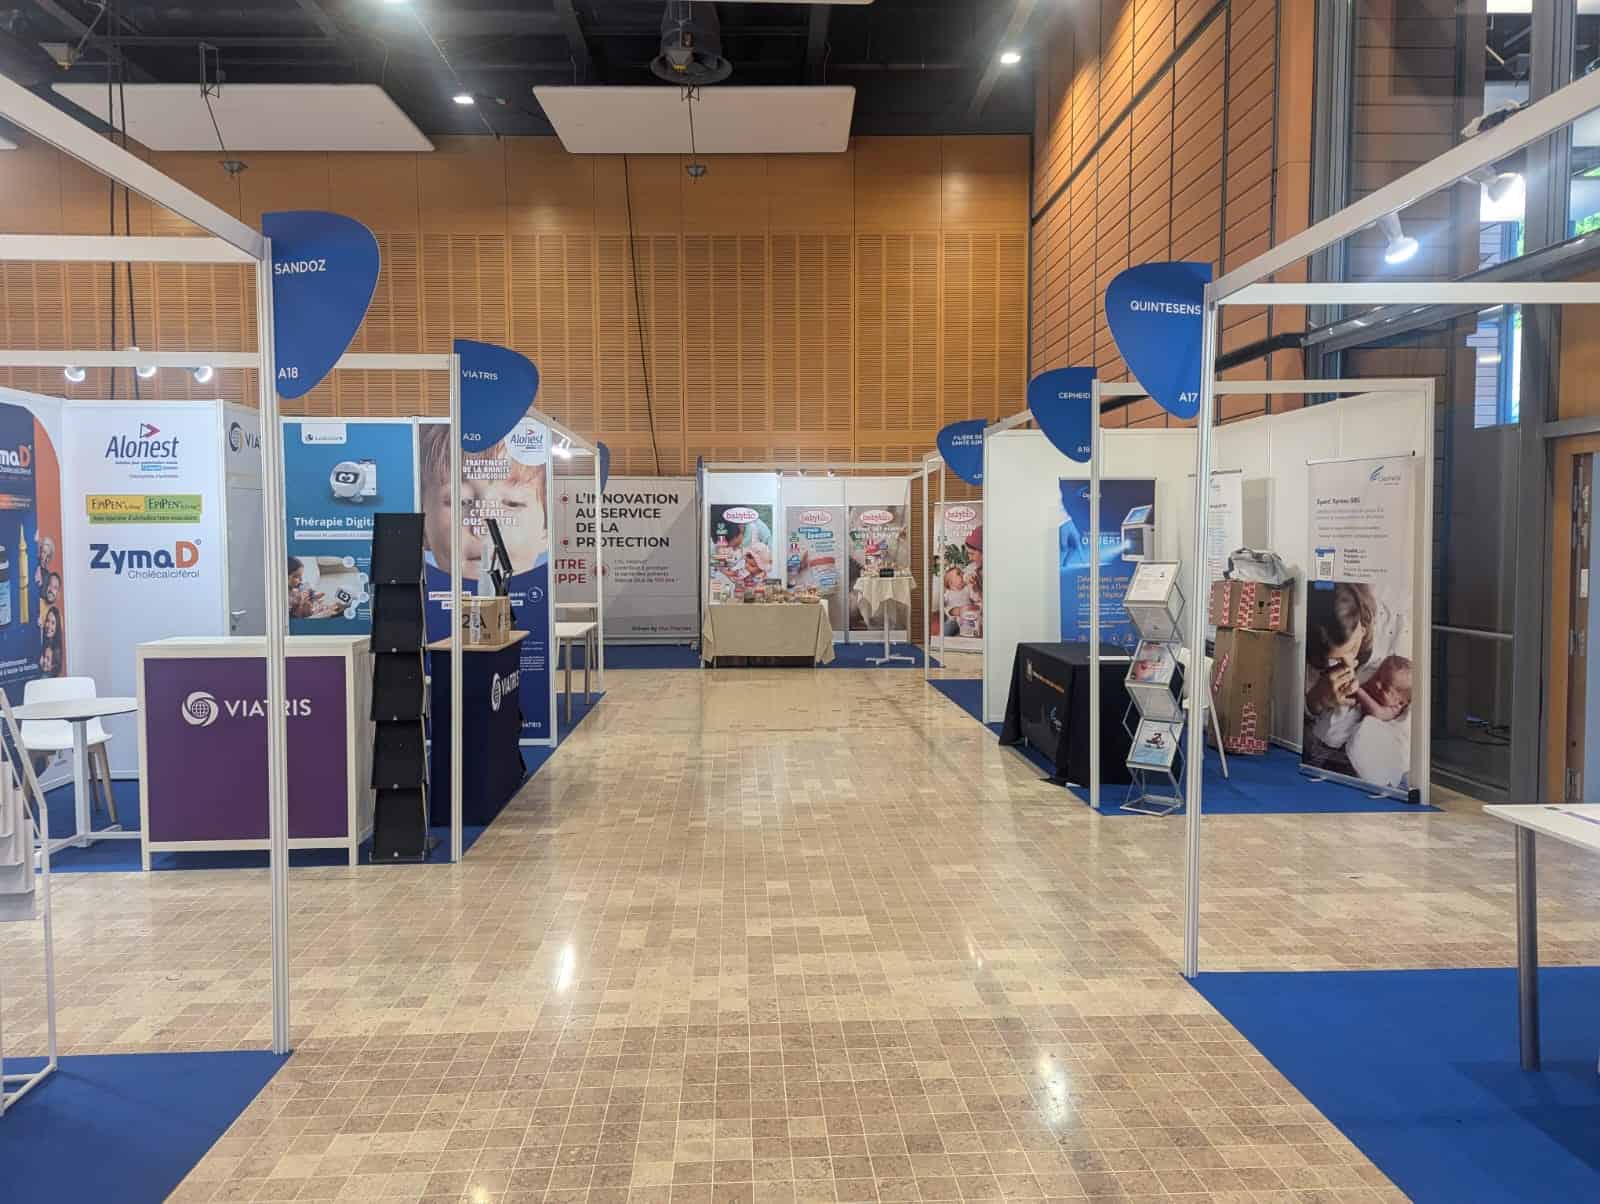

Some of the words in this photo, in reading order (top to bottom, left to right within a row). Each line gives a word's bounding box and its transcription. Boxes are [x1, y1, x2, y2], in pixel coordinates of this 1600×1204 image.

[274, 259, 327, 275] SANDOZ
[1130, 300, 1202, 316] QUINTESENS
[278, 367, 299, 379] A18
[462, 370, 498, 381] VIATRIS
[1179, 392, 1199, 403] A17
[463, 433, 481, 442] A20
[511, 434, 544, 446] Alonest
[105, 435, 180, 458] Alonest
[576, 493, 679, 505] L'INNOVATION
[575, 508, 597, 519] AU
[600, 508, 662, 519] SERVICE
[293, 516, 343, 529] Thérapie
[346, 516, 375, 529] Digit
[576, 522, 597, 533] DE
[600, 522, 620, 533] LA
[576, 537, 670, 548] PROTECTION
[89, 540, 201, 575] ZymaD
[501, 670, 520, 697] VIATRIS
